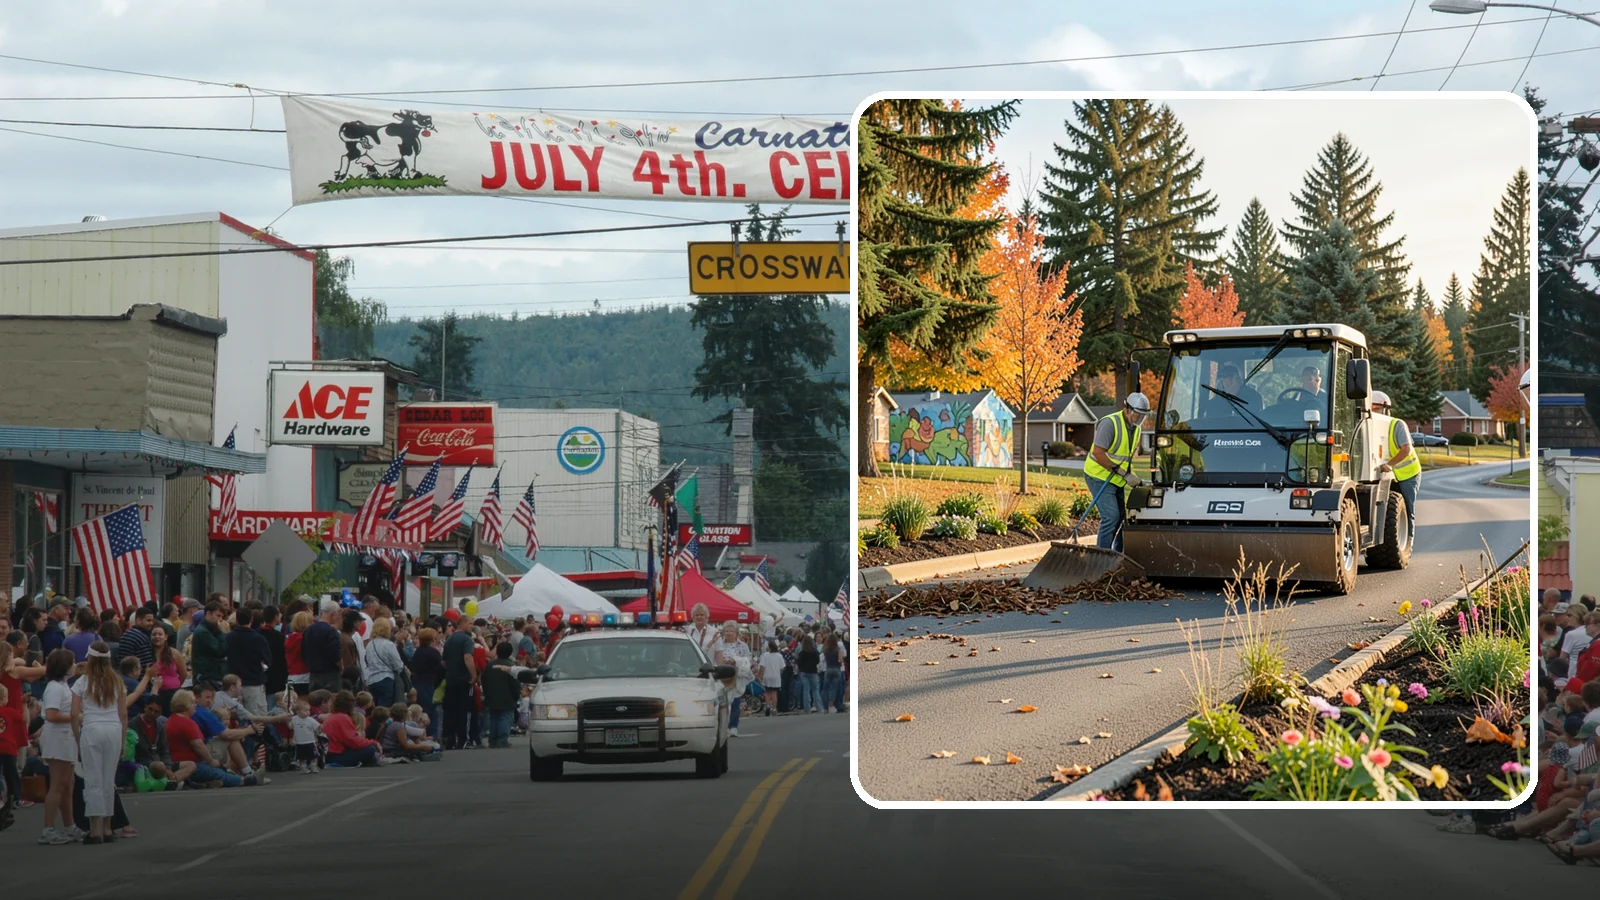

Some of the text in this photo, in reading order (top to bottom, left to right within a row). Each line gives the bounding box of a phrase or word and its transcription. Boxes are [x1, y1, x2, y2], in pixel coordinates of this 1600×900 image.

[481, 141, 605, 192] JULY
[632, 150, 746, 198] 4th.
[697, 254, 850, 280] CROSSWA
[283, 380, 373, 419] ACE
[405, 409, 453, 422] CEDAR
[283, 421, 370, 436] Hardware
[416, 428, 476, 447] Coca-Cola
[353, 467, 386, 480] Simpl
[95, 485, 124, 495] Vincent
[126, 485, 136, 494] de
[137, 486, 155, 495] Paul
[212, 516, 330, 535] HARDARE
[688, 527, 741, 535] CRNATION
[699, 535, 730, 543] GLASS
